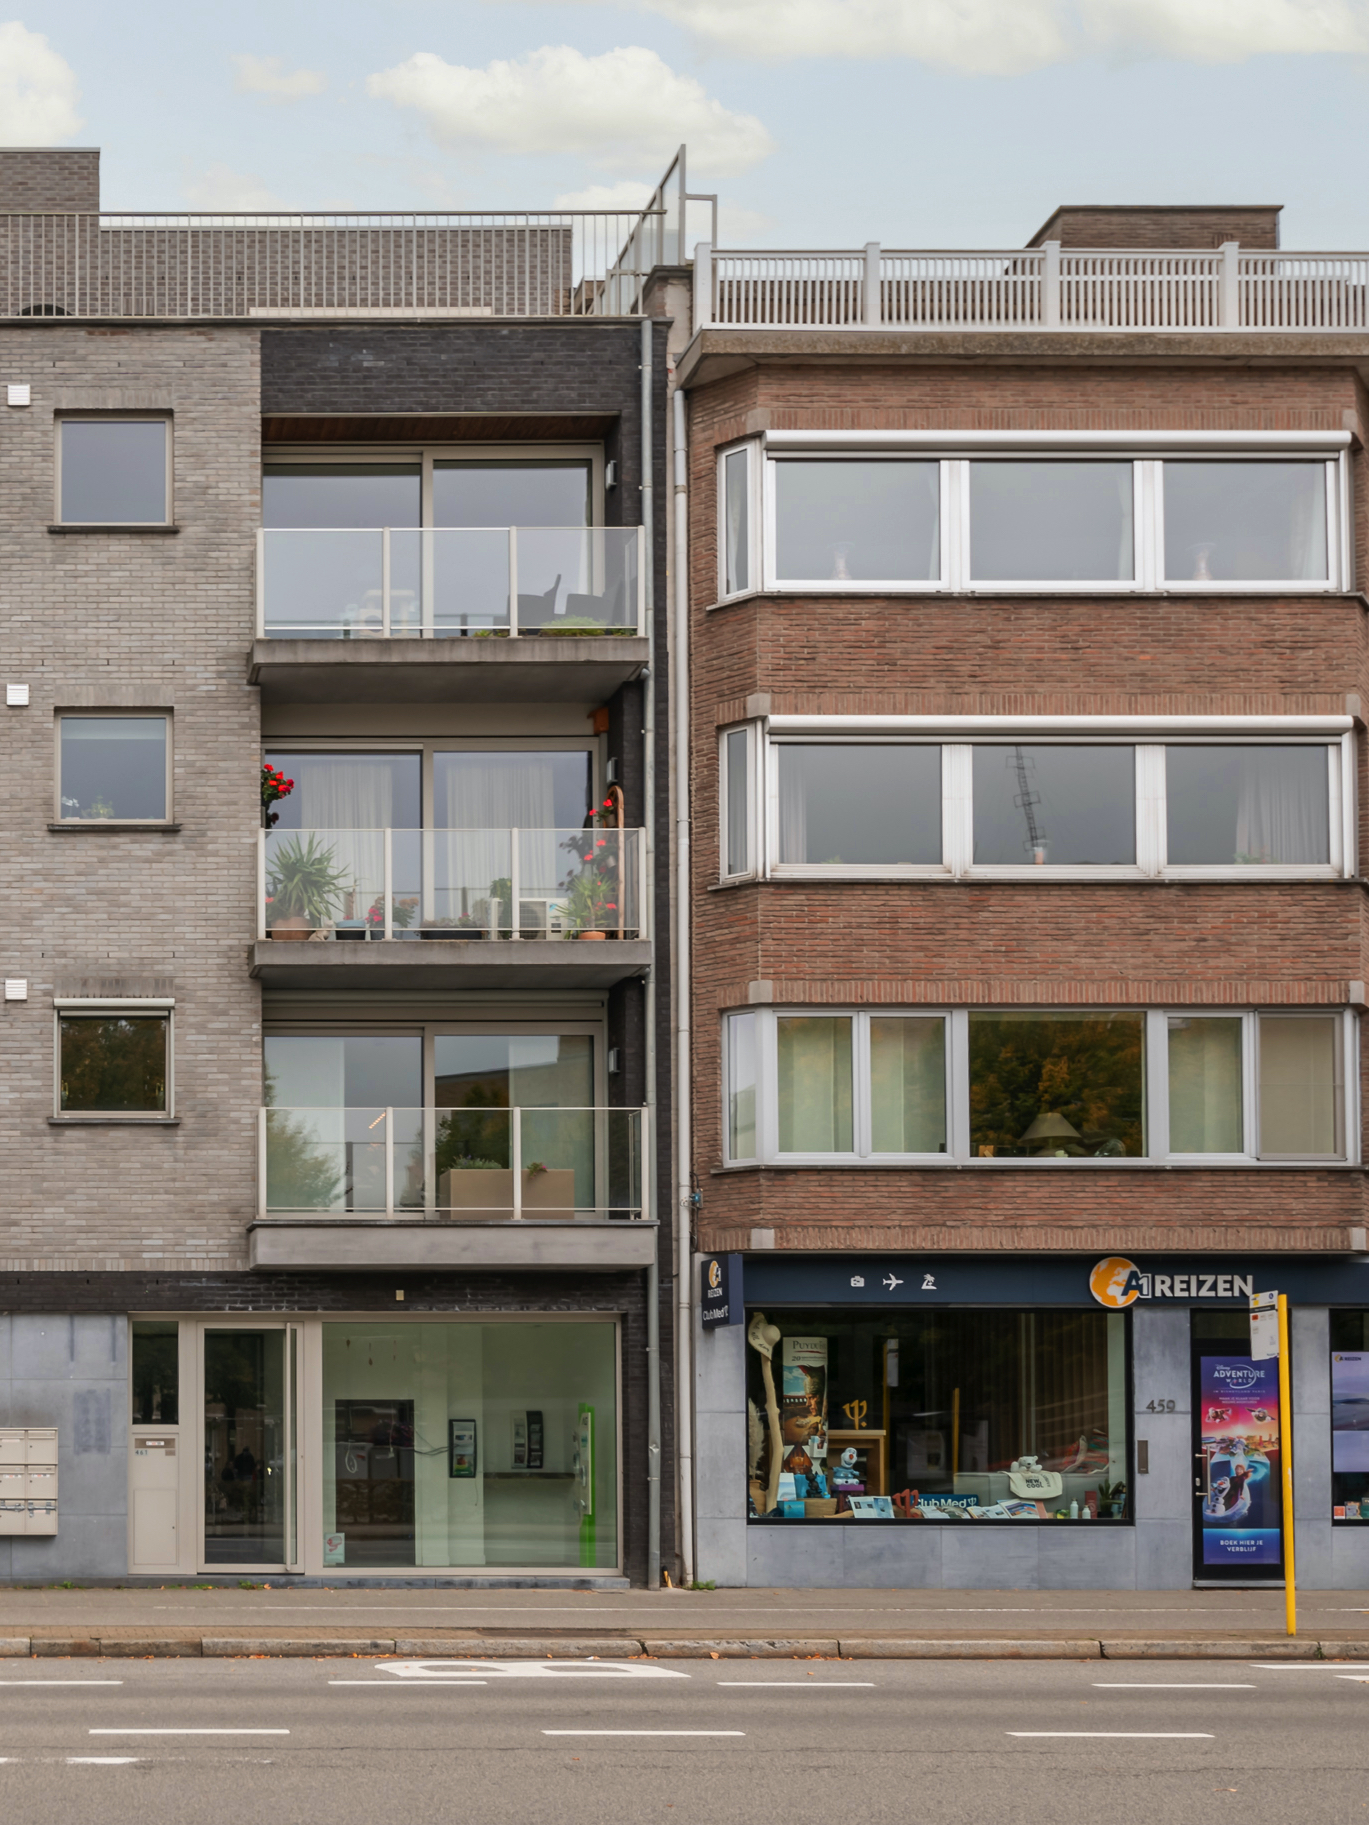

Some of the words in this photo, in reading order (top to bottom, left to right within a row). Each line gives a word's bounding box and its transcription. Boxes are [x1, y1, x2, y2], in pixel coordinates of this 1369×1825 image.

[1154, 1275, 1254, 1297] REIZEN
[1146, 1399, 1175, 1413] 459
[941, 1499, 966, 1508] Med
